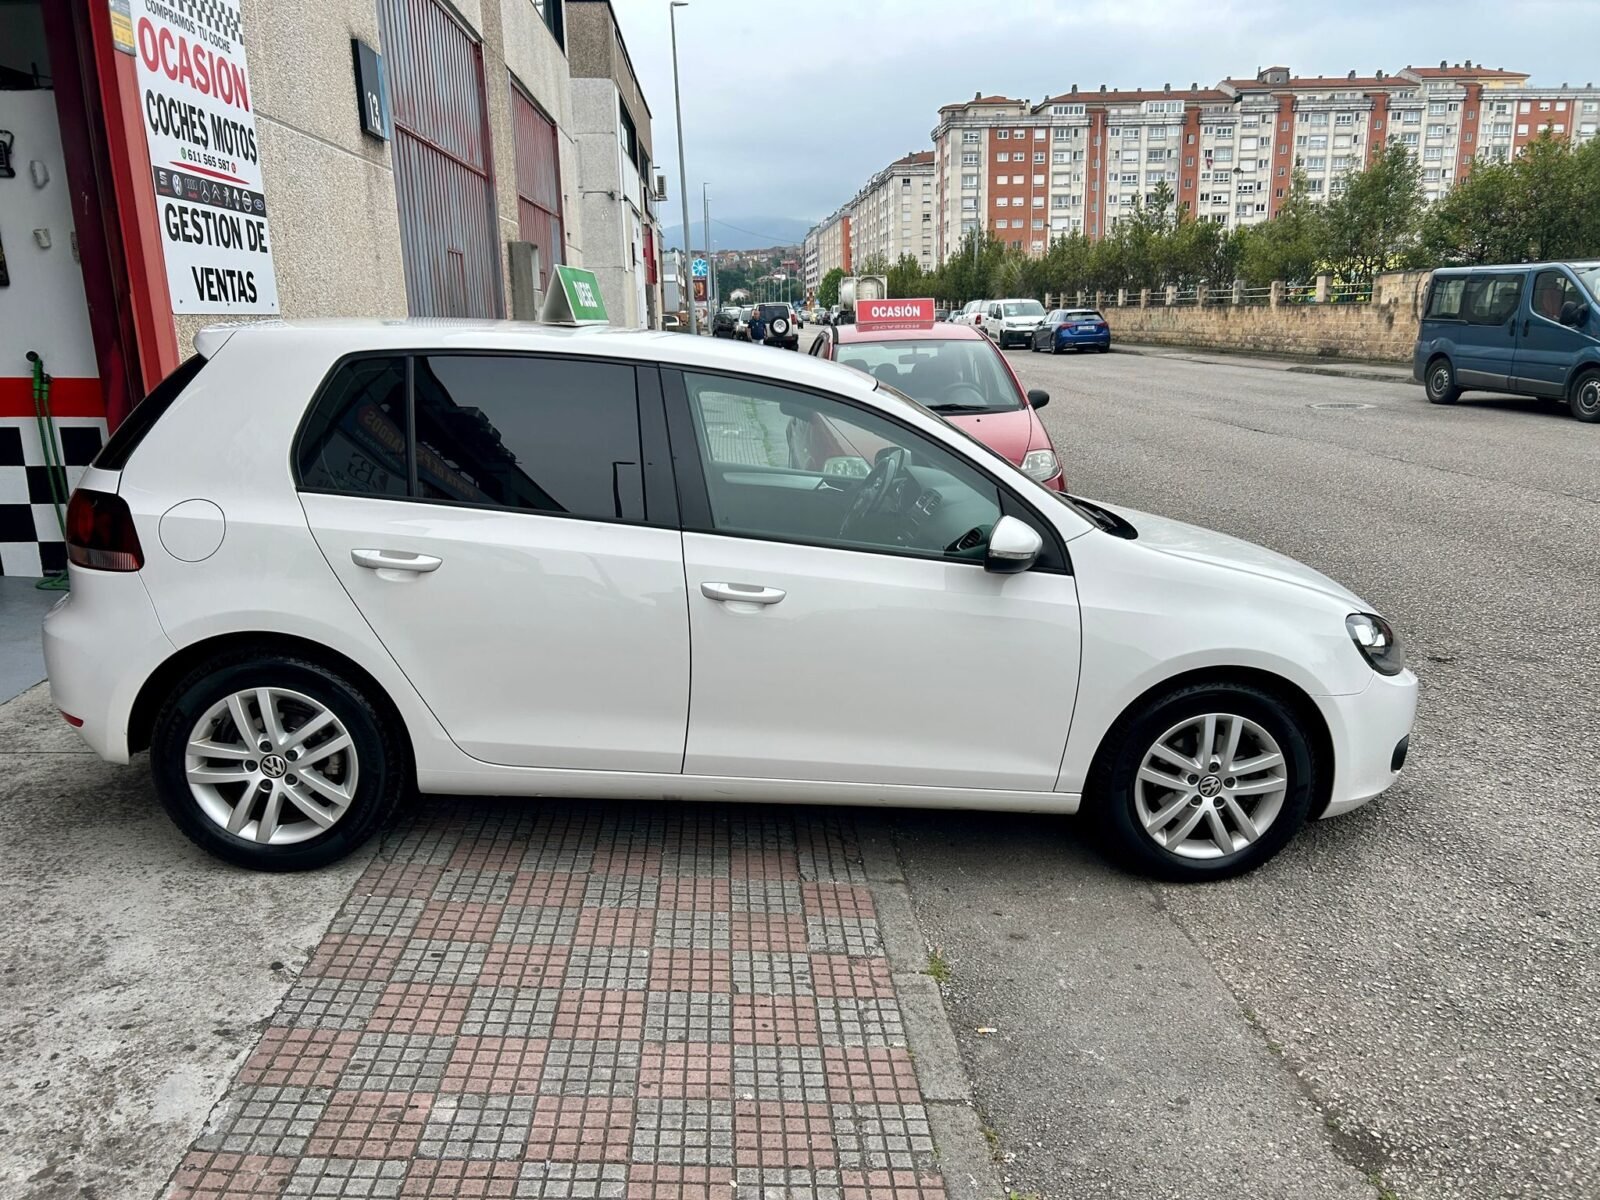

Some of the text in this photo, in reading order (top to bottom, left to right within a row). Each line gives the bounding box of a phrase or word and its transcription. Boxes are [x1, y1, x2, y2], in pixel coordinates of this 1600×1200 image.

[145, 0, 195, 34] COMPRAMOS
[197, 25, 207, 41] TU
[208, 32, 231, 54] COCHE
[137, 16, 249, 112] OCASION
[146, 89, 257, 164] COCHES MOTOS
[368, 91, 381, 130] 13
[187, 149, 201, 163] 611
[203, 153, 217, 168] 565
[165, 203, 268, 253] GESTION DE
[191, 266, 257, 303] VENTAS
[871, 303, 921, 318] OCASIÓN
